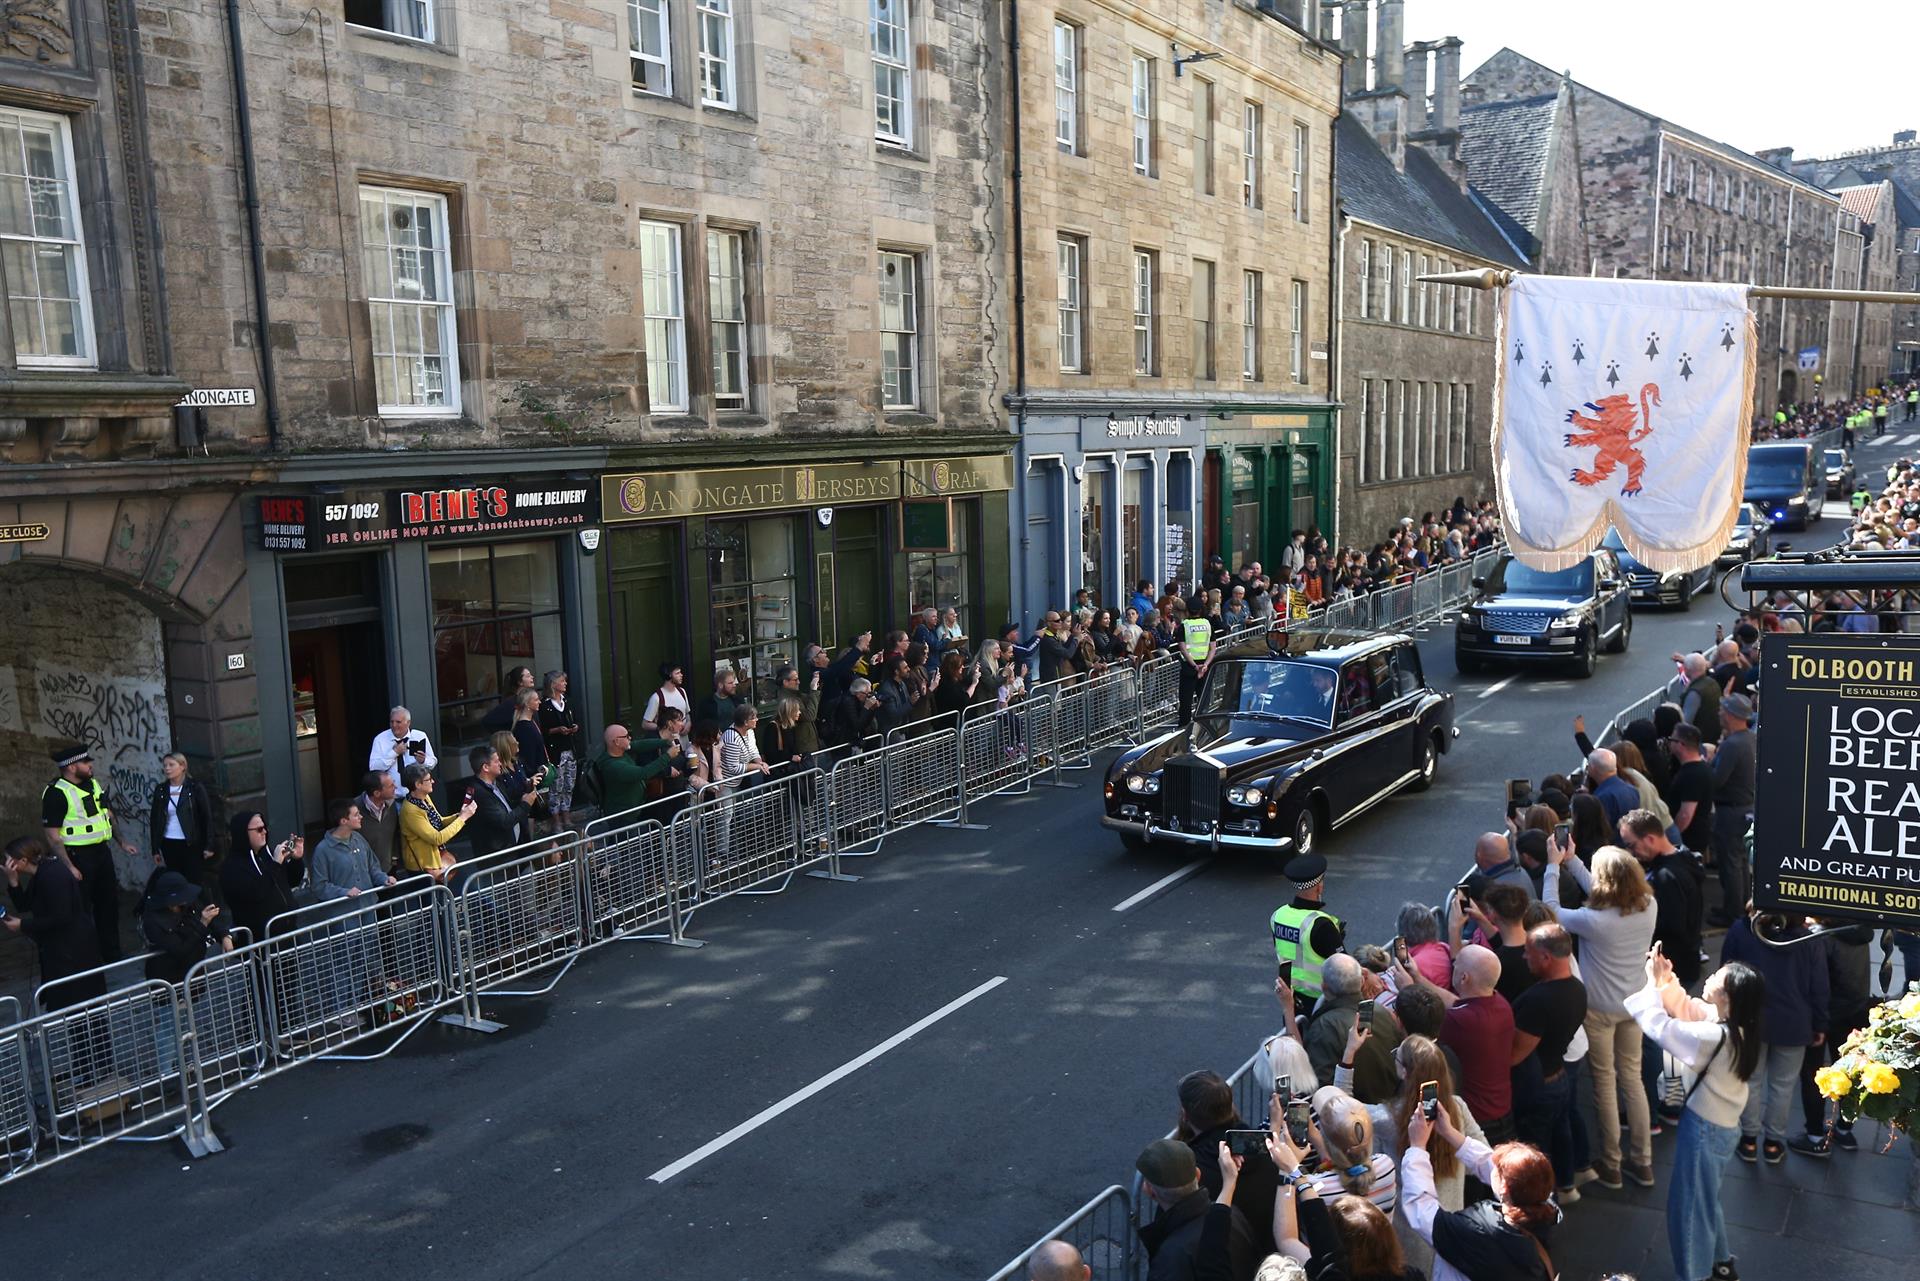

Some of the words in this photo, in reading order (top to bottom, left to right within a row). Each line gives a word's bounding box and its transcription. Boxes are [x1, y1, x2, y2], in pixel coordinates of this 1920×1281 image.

[180, 390, 250, 405] ANONGATE
[1107, 416, 1143, 440] Simply
[1145, 416, 1181, 438] Scottish
[619, 476, 785, 515] CANONGATE
[796, 467, 890, 501] JERSEYS
[910, 475, 922, 495] &
[400, 486, 508, 524] BENE'S
[515, 492, 543, 508] HOME
[544, 489, 587, 506] DELIVERY
[261, 497, 305, 524] BENE'S
[325, 504, 348, 521] 557
[350, 502, 380, 519] 1092
[12, 526, 43, 538] CLOSE
[263, 524, 280, 535] HOME
[280, 524, 305, 535] DELIVERY
[353, 528, 398, 542] ONLINE
[403, 526, 429, 538] NOW
[432, 525, 446, 535] AT
[264, 536, 279, 548] 0131
[279, 537, 291, 549] 557
[291, 538, 306, 549] 1092
[229, 656, 243, 667] 160
[1787, 654, 1913, 681] TOLBOOTH
[1846, 687, 1918, 698] ESTABLISHED
[1821, 814, 1920, 860] ALE
[1780, 855, 1822, 873] AND
[1827, 860, 1890, 880] GREAT
[1778, 880, 1879, 906] TRADITIONAL
[1884, 892, 1920, 911] SCO
[1276, 925, 1299, 942] OLICE
